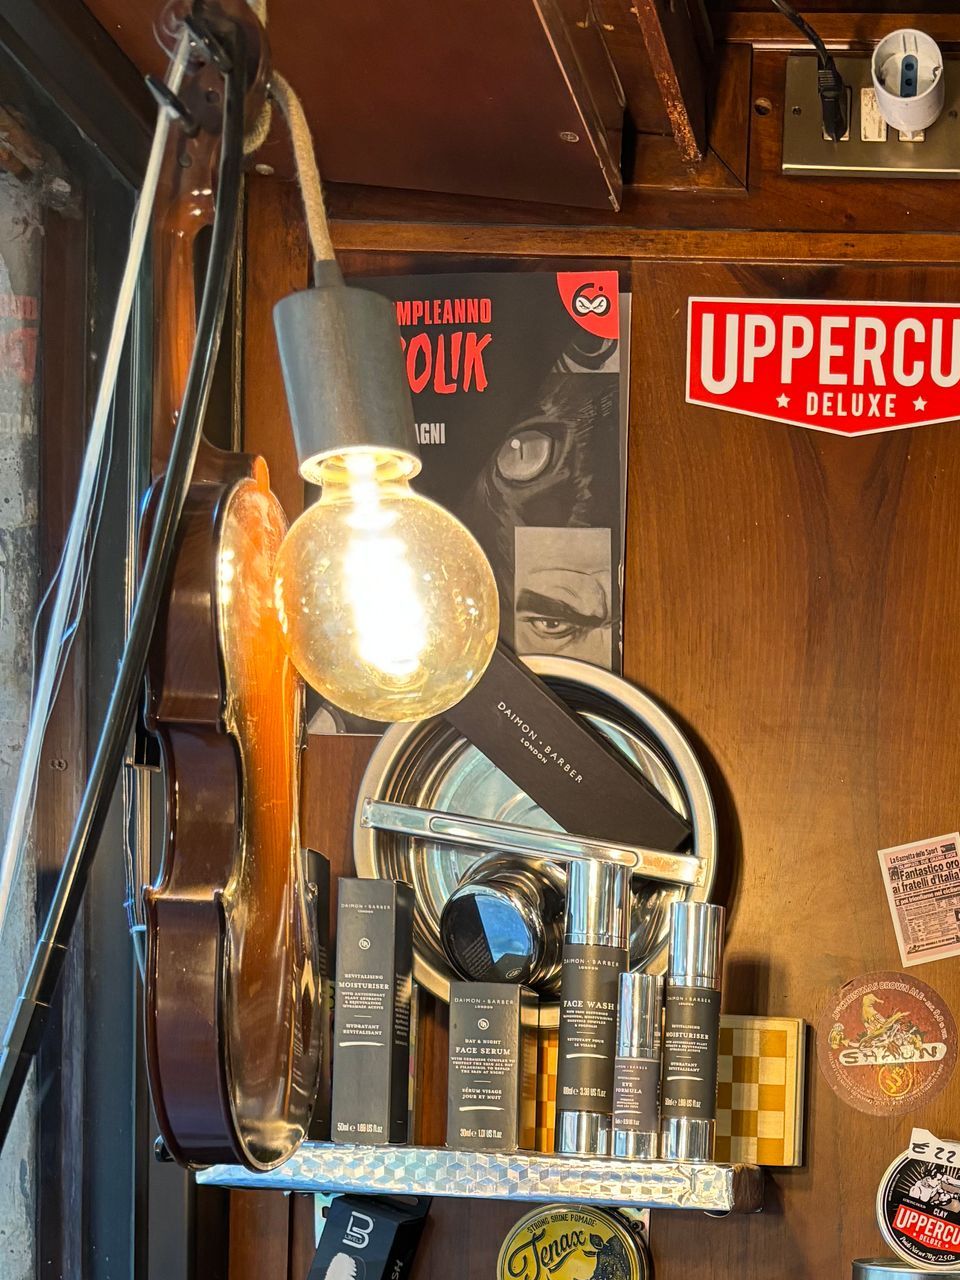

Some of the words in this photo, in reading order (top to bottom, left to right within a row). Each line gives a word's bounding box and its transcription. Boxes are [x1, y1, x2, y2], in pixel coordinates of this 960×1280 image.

[395, 299, 492, 325] MPLEANNO
[400, 332, 492, 394] OLIK
[806, 391, 897, 418] DELUXE
[498, 702, 538, 740] DAIMON
[544, 746, 583, 783] BARBER
[520, 737, 548, 763] LONDON
[900, 864, 944, 880] Fantastico
[946, 859, 959, 868] oro
[893, 885, 900, 893] ai
[902, 877, 929, 892] fratelli
[592, 959, 619, 967] BARBER
[338, 982, 390, 990] MOISTURISER
[587, 1001, 615, 1010] WASH
[935, 1147, 956, 1163] 22
[570, 1214, 597, 1227] POMADE
[933, 1208, 948, 1219] CLAY
[920, 1234, 942, 1247] DELUXE
